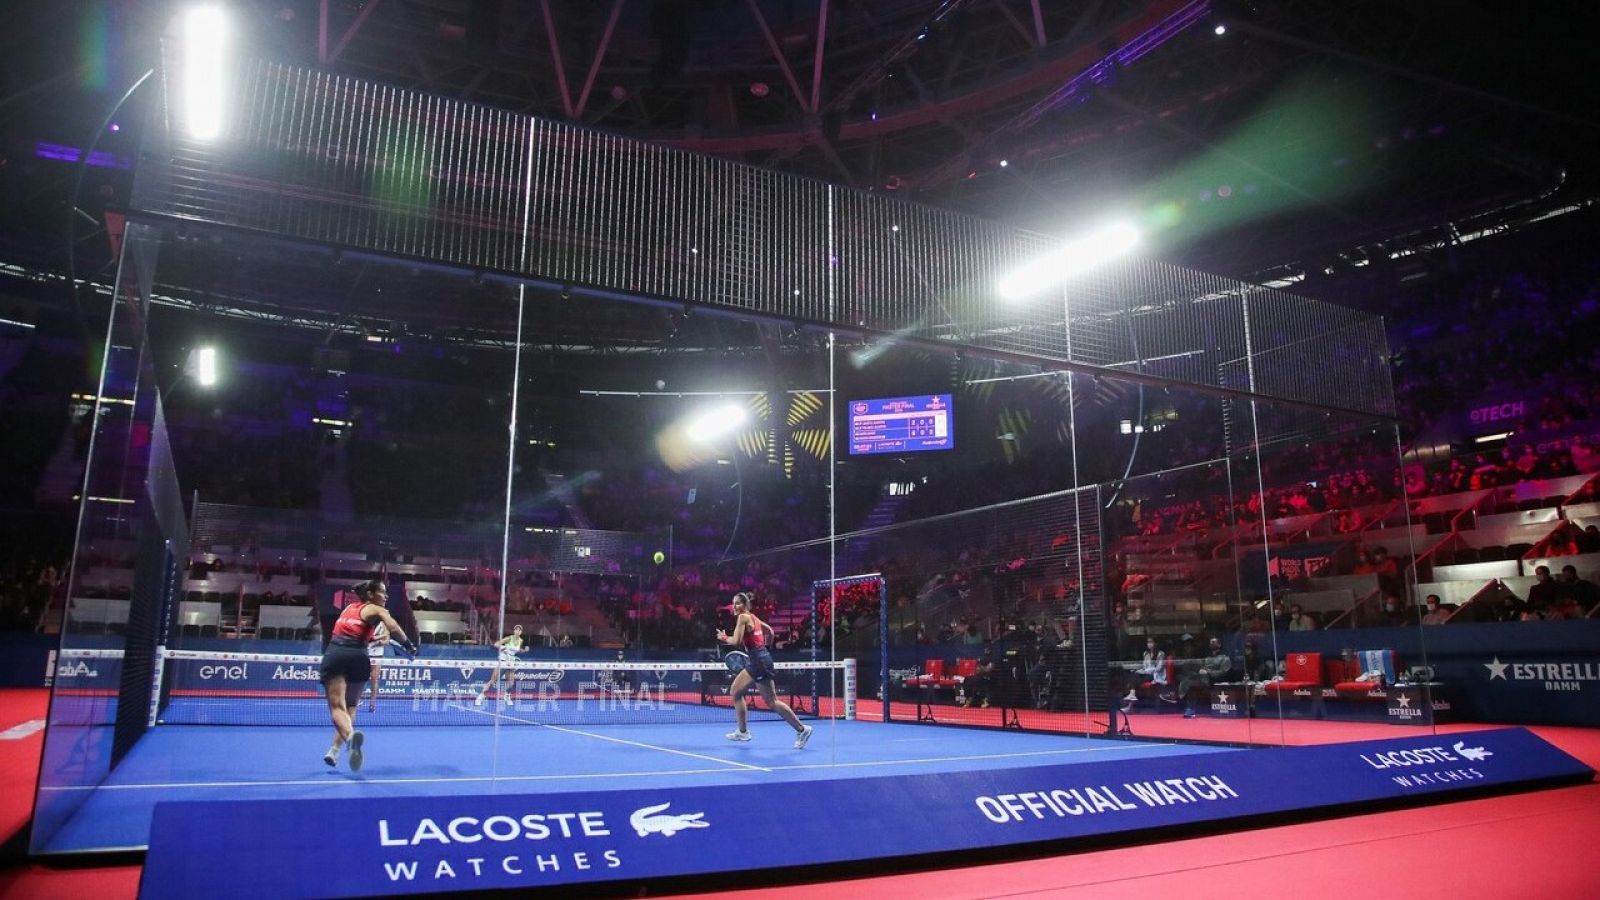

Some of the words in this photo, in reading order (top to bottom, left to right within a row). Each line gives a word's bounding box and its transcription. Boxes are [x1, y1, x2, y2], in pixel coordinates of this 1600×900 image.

[199, 663, 248, 680] enel
[272, 664, 322, 681] Adesla
[1514, 663, 1600, 681] ESTRELL
[1545, 681, 1581, 691] DAMM
[1388, 708, 1422, 716] ESTRELLA
[1360, 746, 1459, 769] LACOSTE
[1391, 767, 1485, 787] WATCHES
[974, 784, 1137, 824] OFFICIAL
[1130, 774, 1239, 808] WATCH
[378, 811, 611, 847] LACOSTE
[384, 850, 622, 881] WATCHES
